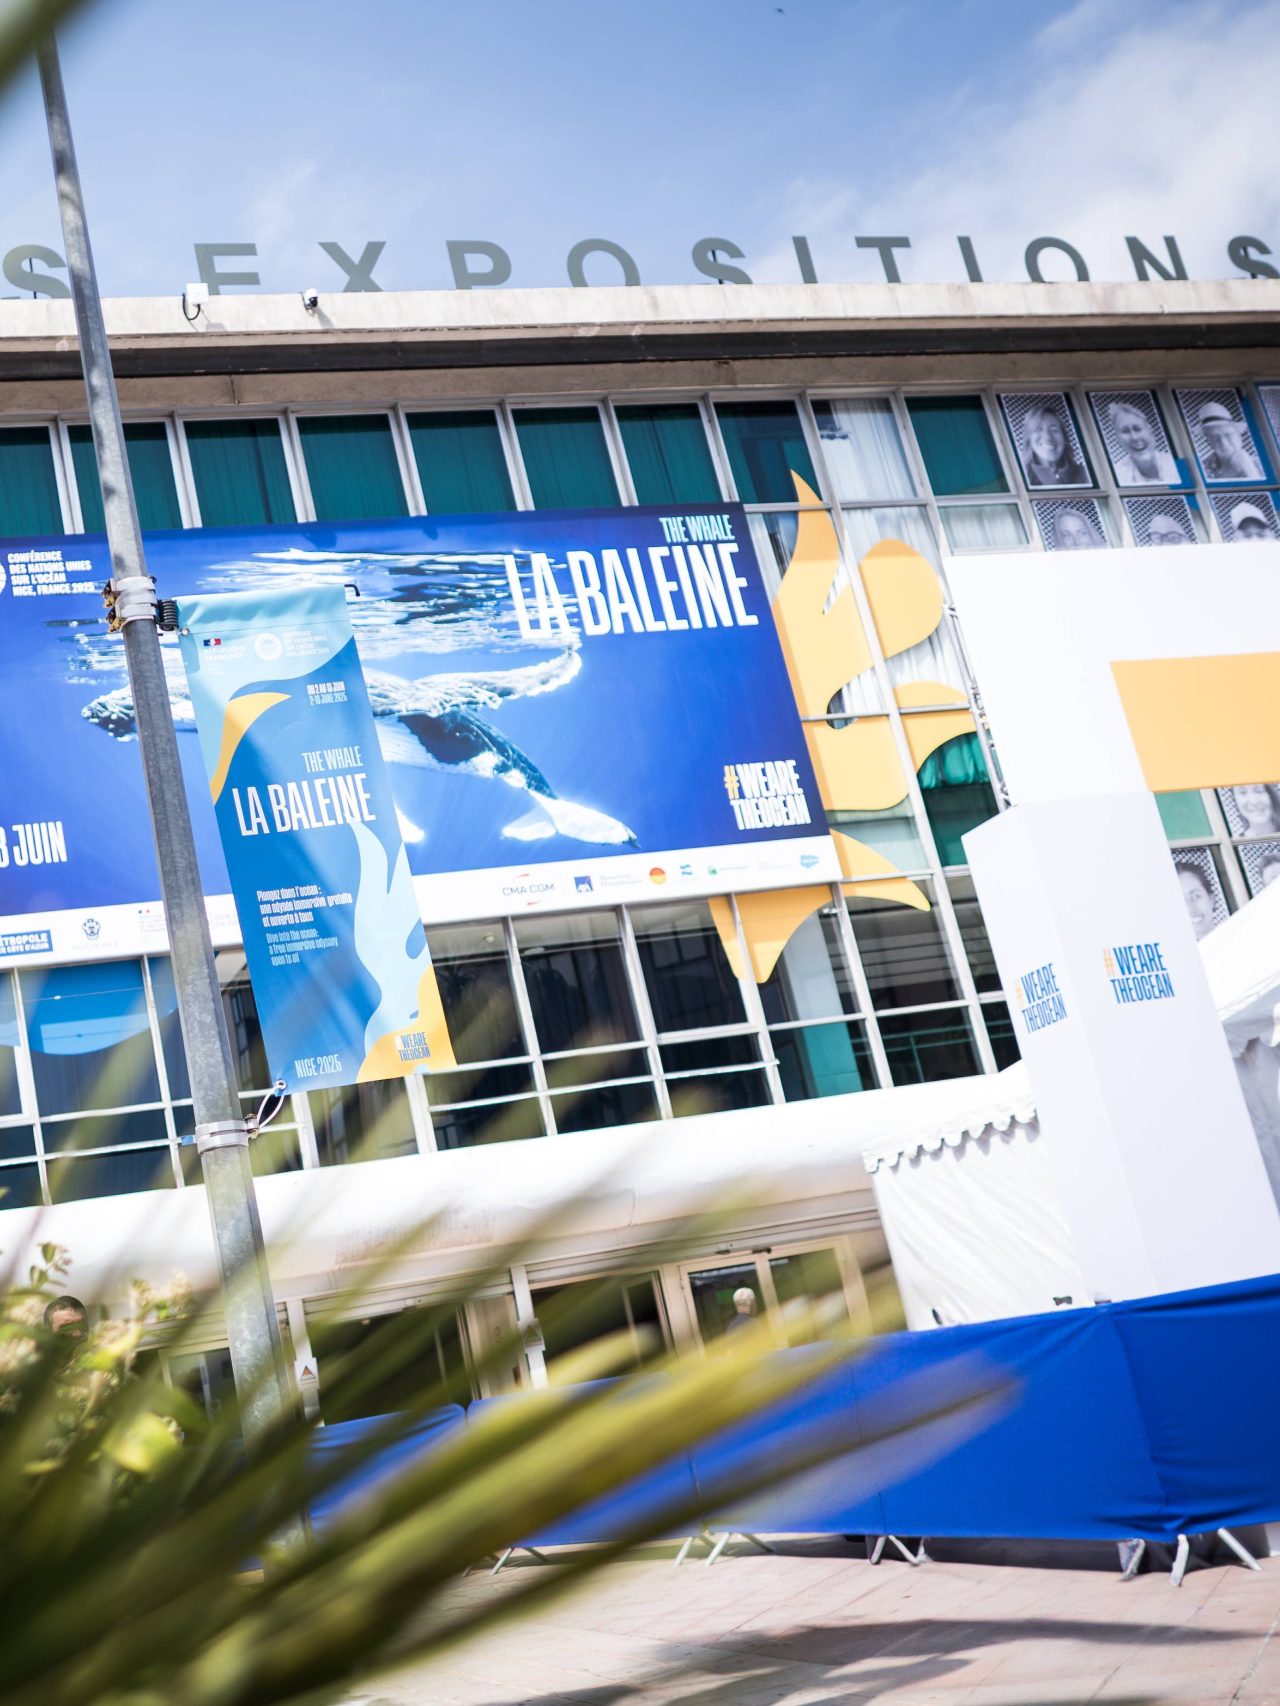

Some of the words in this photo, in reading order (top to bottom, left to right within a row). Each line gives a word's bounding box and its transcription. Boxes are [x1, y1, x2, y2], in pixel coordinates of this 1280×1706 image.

[194, 235, 1280, 296] EXPOSITIONS
[659, 516, 688, 543] THE
[686, 514, 735, 541] WHALE
[503, 553, 572, 639] LA
[567, 543, 759, 636] BALEINE
[301, 750, 324, 773] THE
[323, 745, 363, 771] WHALE
[723, 759, 804, 800] #WEARE
[232, 786, 270, 836] LA
[267, 773, 376, 833] BALEINE
[729, 793, 812, 830] THEOCEAN
[11, 821, 68, 867] JUIN
[502, 885, 527, 896] CMA
[1102, 943, 1167, 977] #WEARE
[1110, 973, 1175, 1004] THEOCEAN
[1021, 993, 1068, 1034] THEOCEAN
[294, 1057, 319, 1079] NICE
[317, 1053, 343, 1075] 2025
